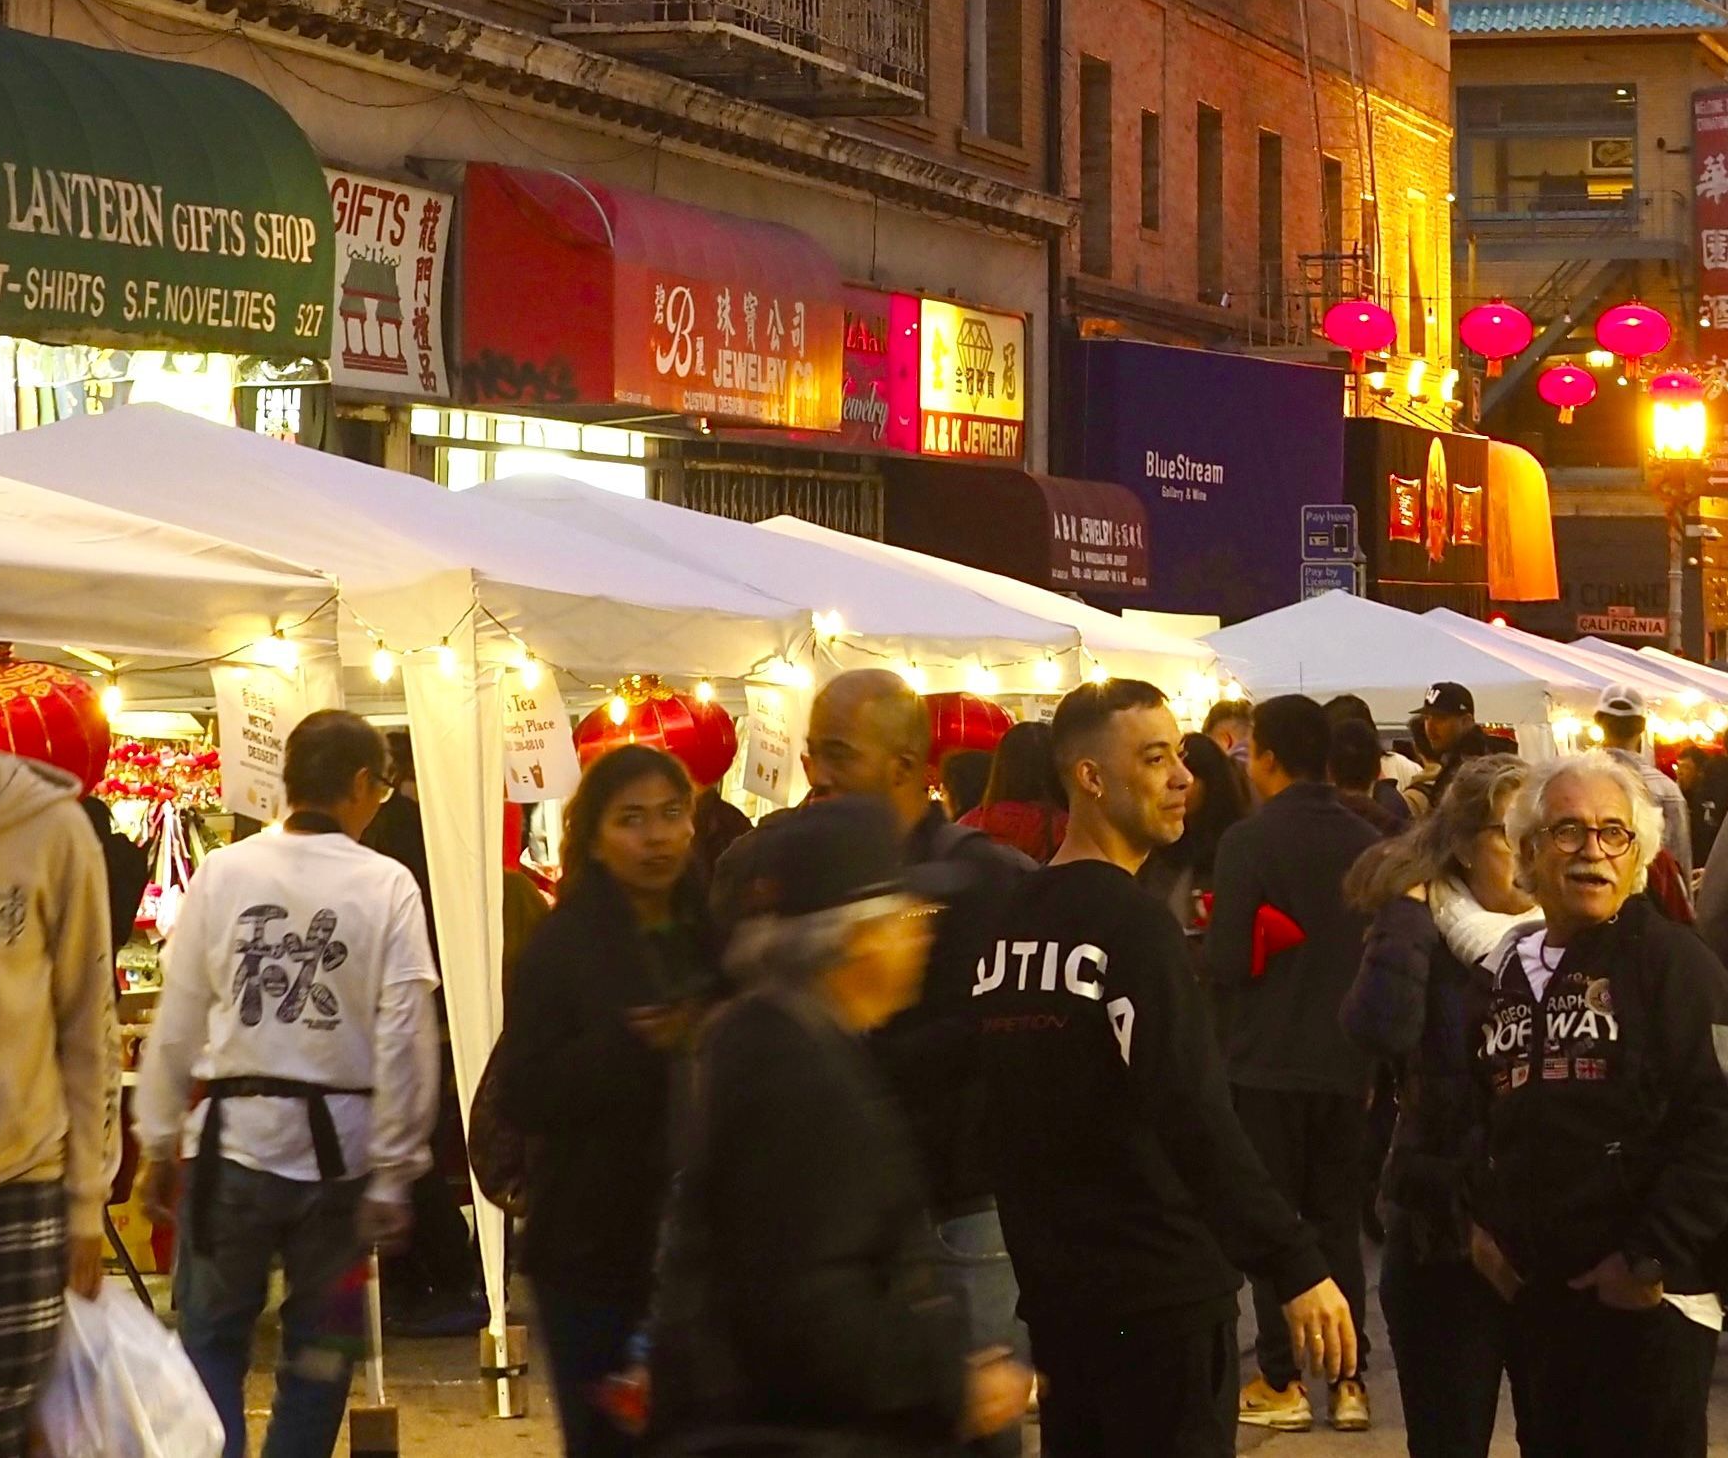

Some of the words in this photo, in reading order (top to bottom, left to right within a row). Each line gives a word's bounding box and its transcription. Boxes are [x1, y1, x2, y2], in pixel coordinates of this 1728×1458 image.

[3, 161, 164, 249] LANTERN
[172, 203, 246, 258] GIFTS
[255, 214, 317, 265] SHOP
[331, 178, 410, 247] GIFTS
[295, 303, 324, 338] 527
[712, 348, 788, 396] JEWELRY
[963, 420, 1019, 457] JEWELRY
[1145, 450, 1224, 484] BlueStream
[1306, 511, 1324, 524] Pay
[1325, 512, 1352, 522] here
[1080, 517, 1113, 547] JEWELRY
[1305, 567, 1323, 578] Pay
[1325, 567, 1339, 578] by
[1305, 578, 1342, 587] License
[1579, 618, 1664, 634] CALIFORNIA
[511, 694, 537, 712] Tea
[525, 719, 556, 733] Place
[247, 745, 279, 767] DESSERT
